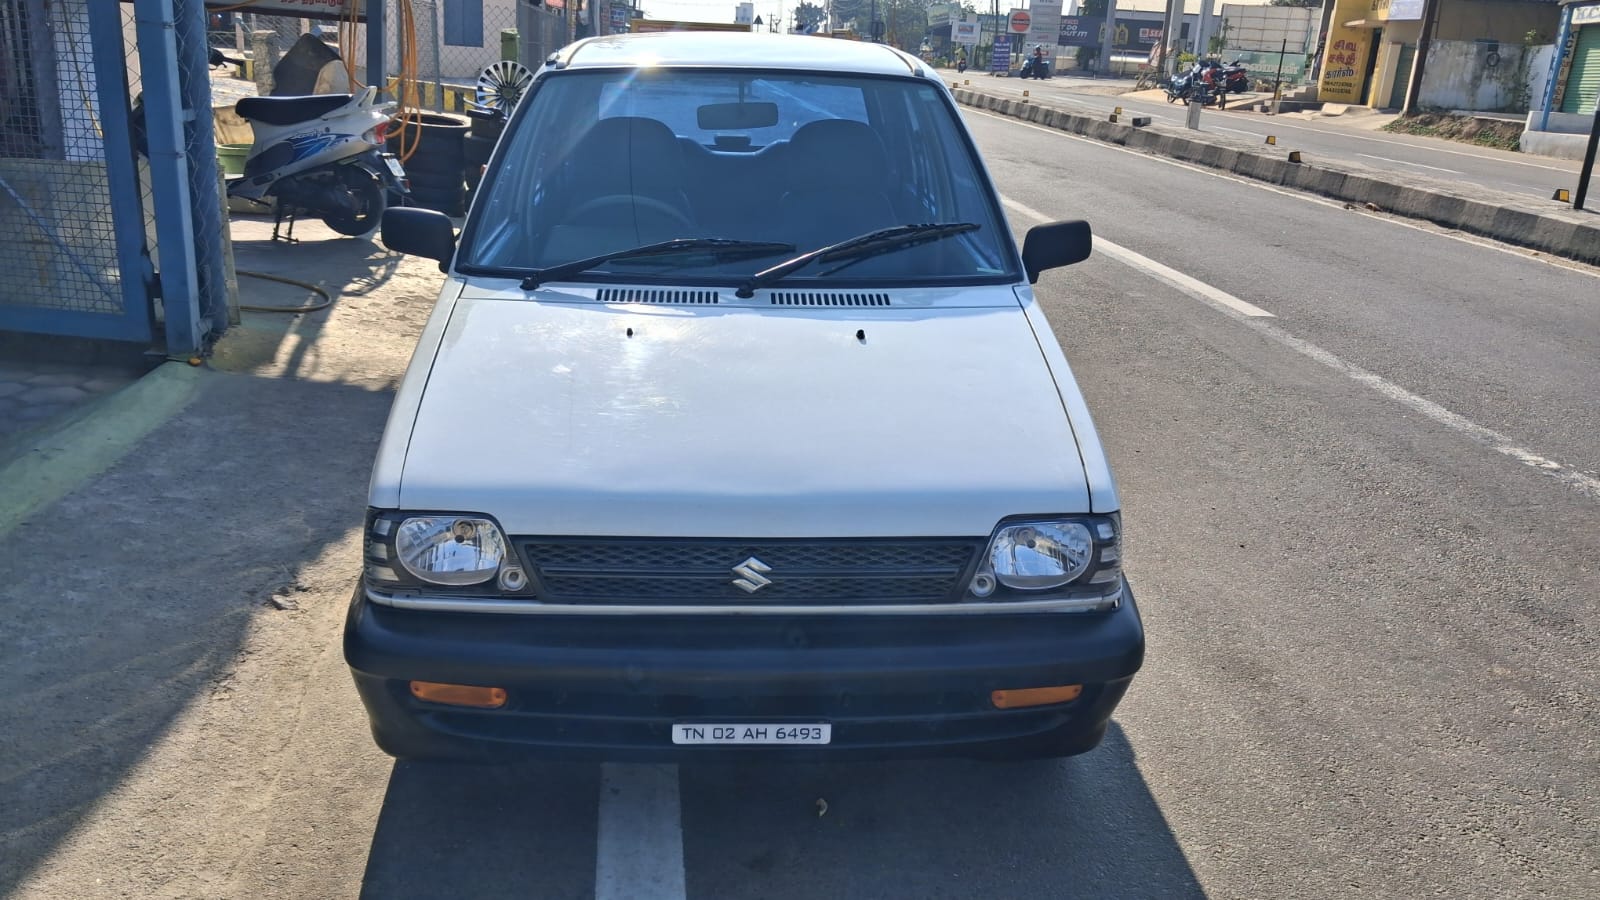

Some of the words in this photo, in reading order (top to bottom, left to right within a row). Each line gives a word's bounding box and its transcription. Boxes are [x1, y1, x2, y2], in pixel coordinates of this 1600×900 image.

[682, 727, 705, 740] TN
[712, 727, 736, 740] 02
[743, 727, 768, 740] AH
[775, 727, 822, 740] 6493
